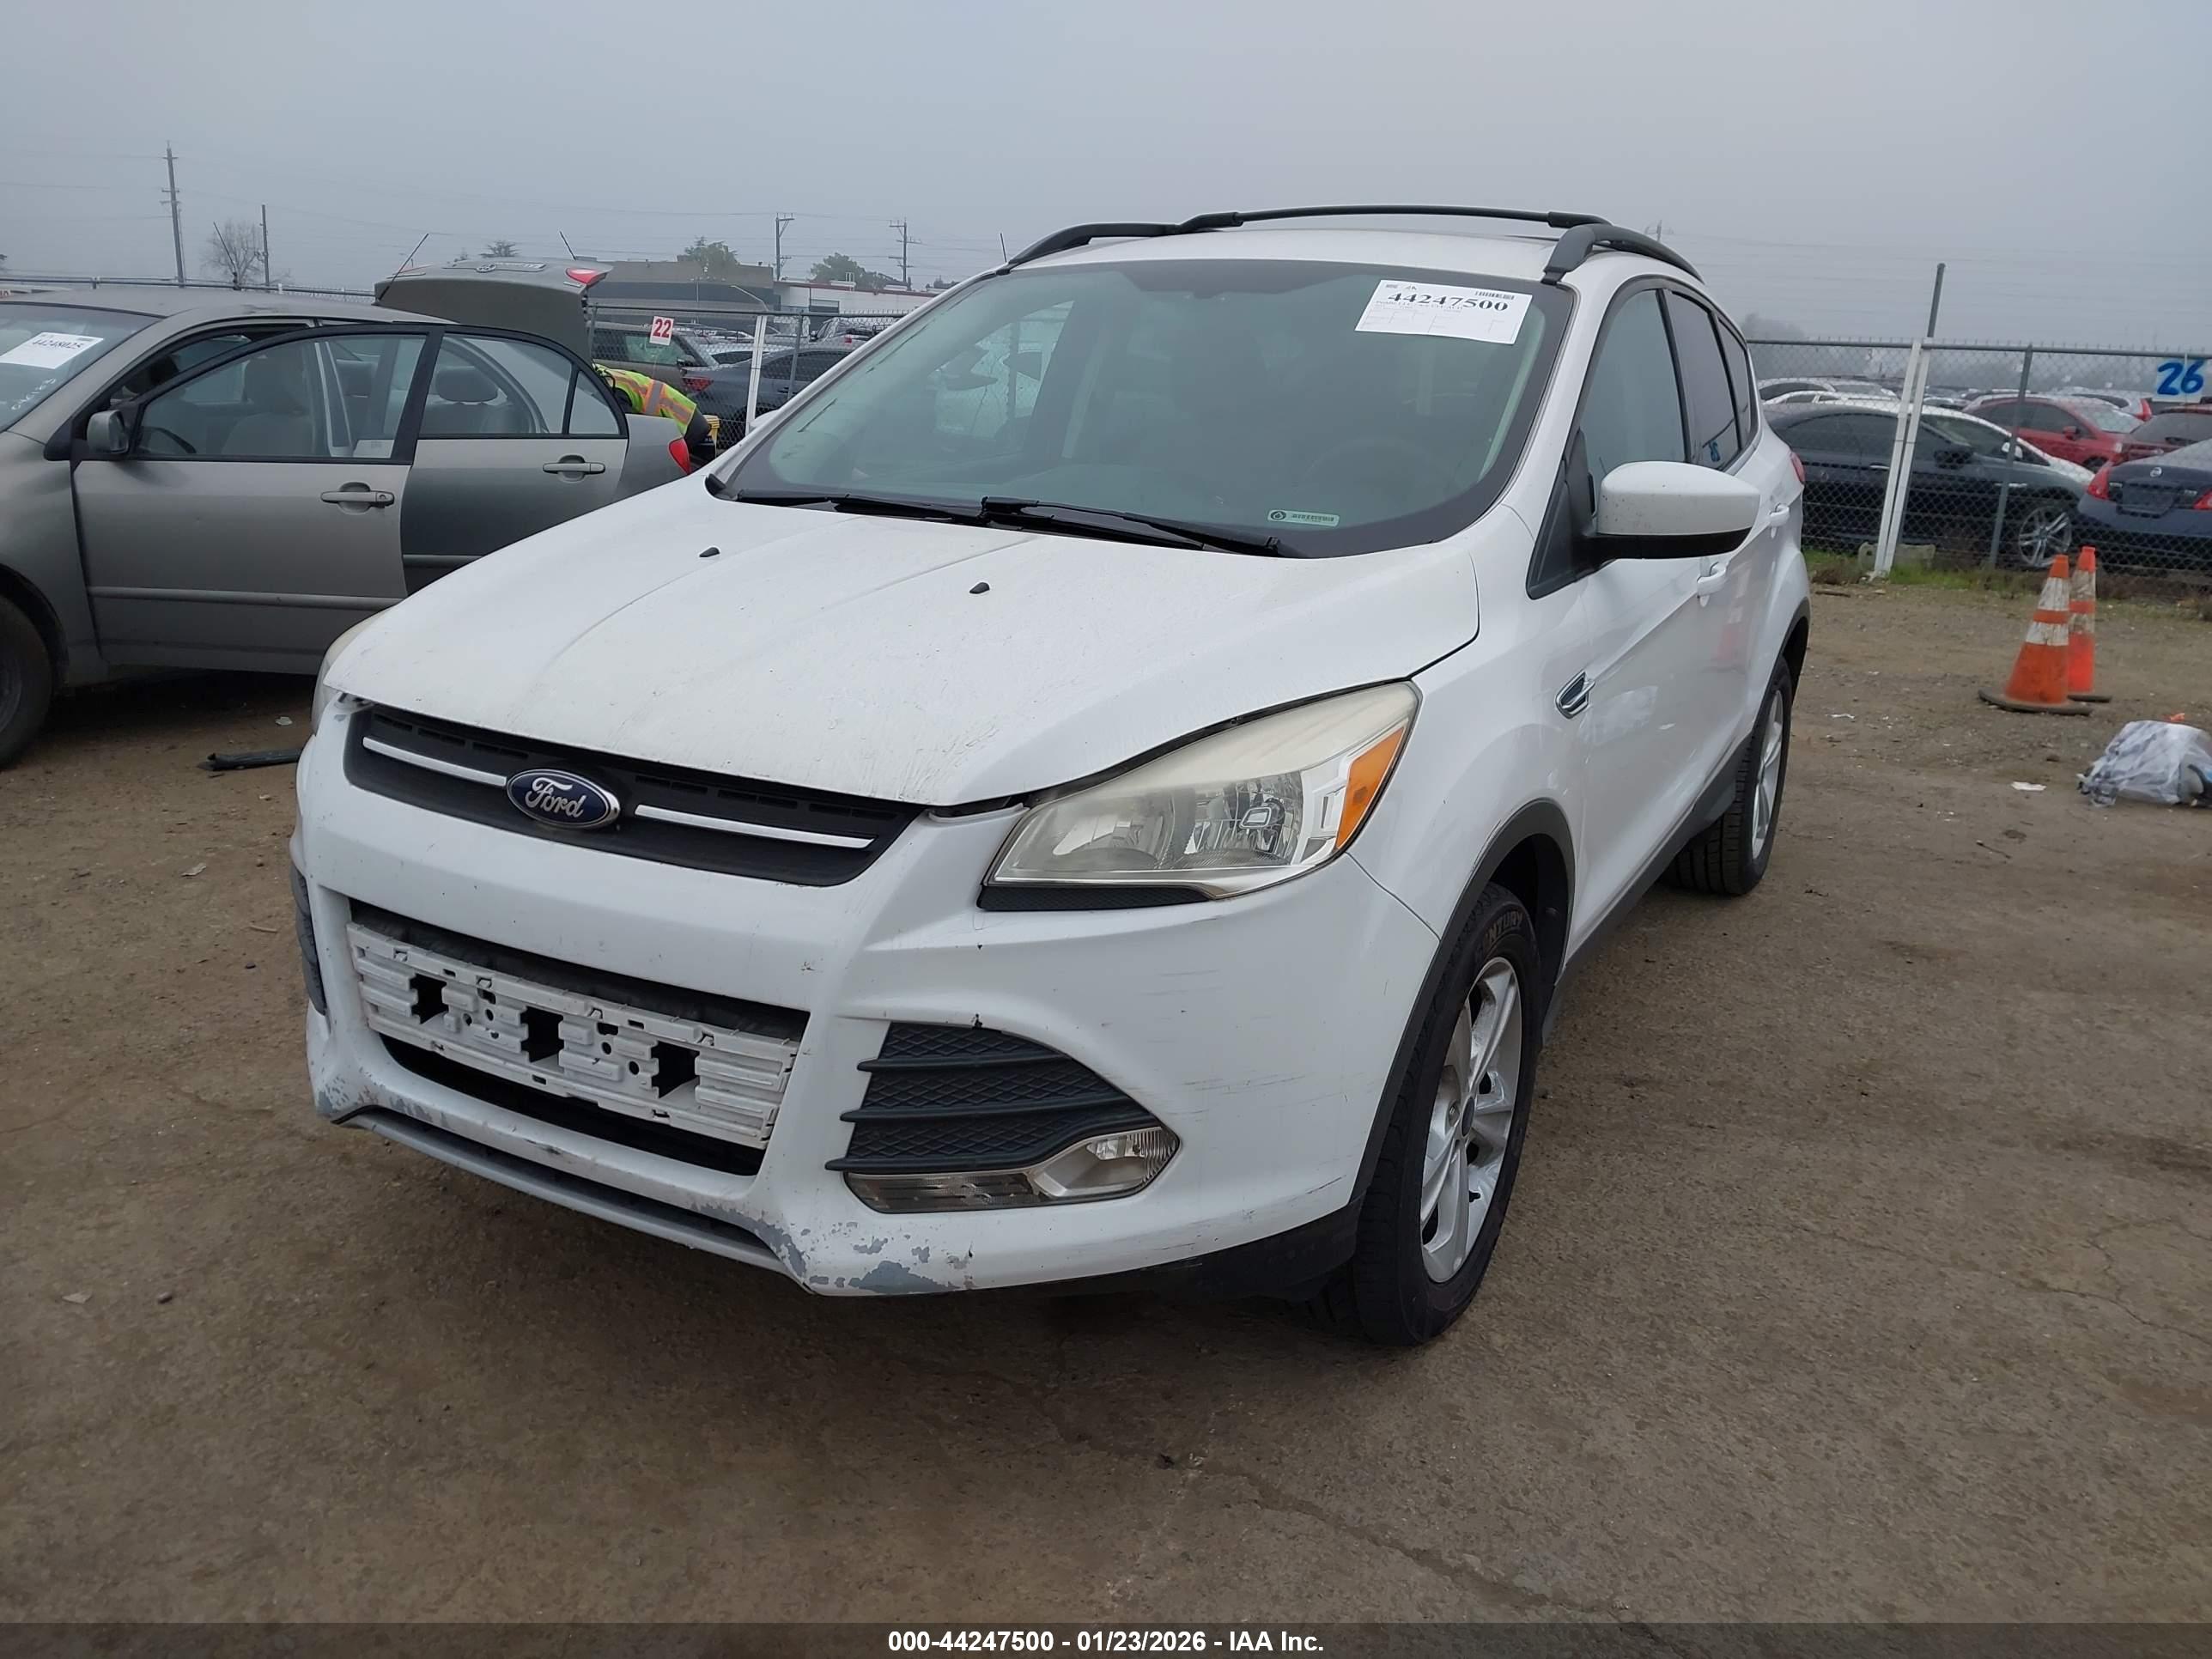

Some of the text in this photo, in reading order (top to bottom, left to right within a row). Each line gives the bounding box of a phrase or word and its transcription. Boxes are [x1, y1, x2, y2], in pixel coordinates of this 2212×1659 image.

[1388, 292, 1509, 312] 44247500
[653, 318, 672, 338] 22
[2157, 357, 2205, 396] 26
[525, 777, 587, 817] Ford
